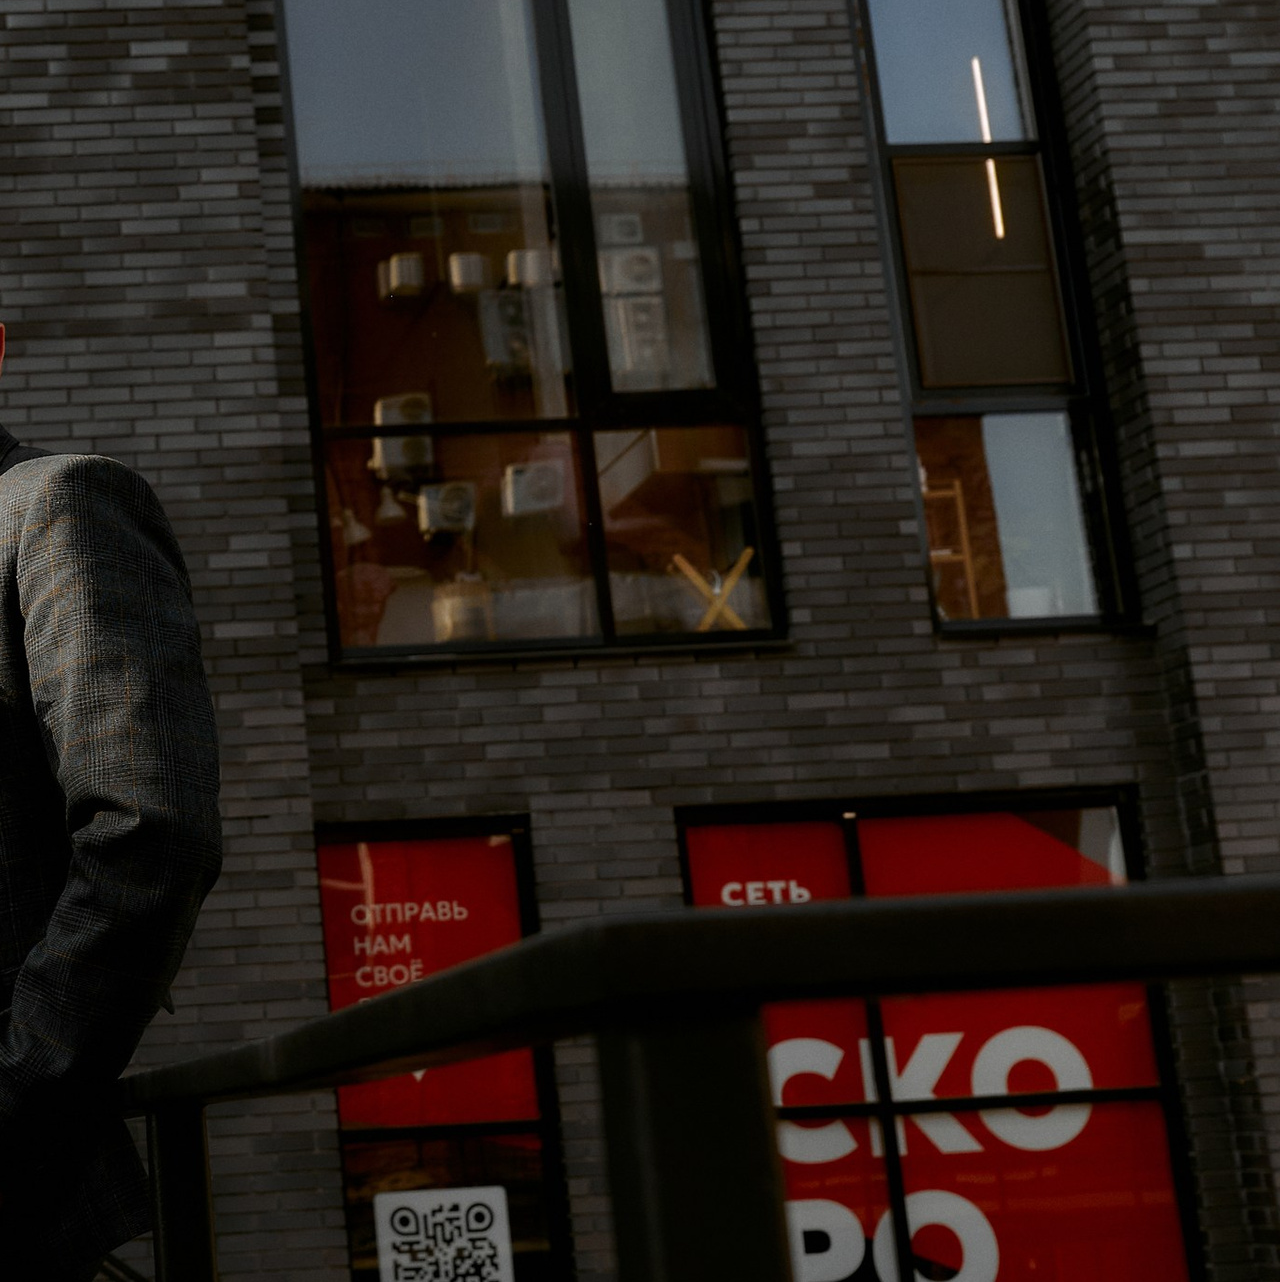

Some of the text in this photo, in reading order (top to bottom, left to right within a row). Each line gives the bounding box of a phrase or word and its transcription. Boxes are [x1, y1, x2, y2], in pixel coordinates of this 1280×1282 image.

[720, 879, 812, 907] СЕТЬ
[350, 899, 469, 927] ОТПРАВЬ
[352, 932, 413, 957] НАМ
[354, 958, 424, 988] СВОЁ
[766, 1024, 1094, 1165] СКО
